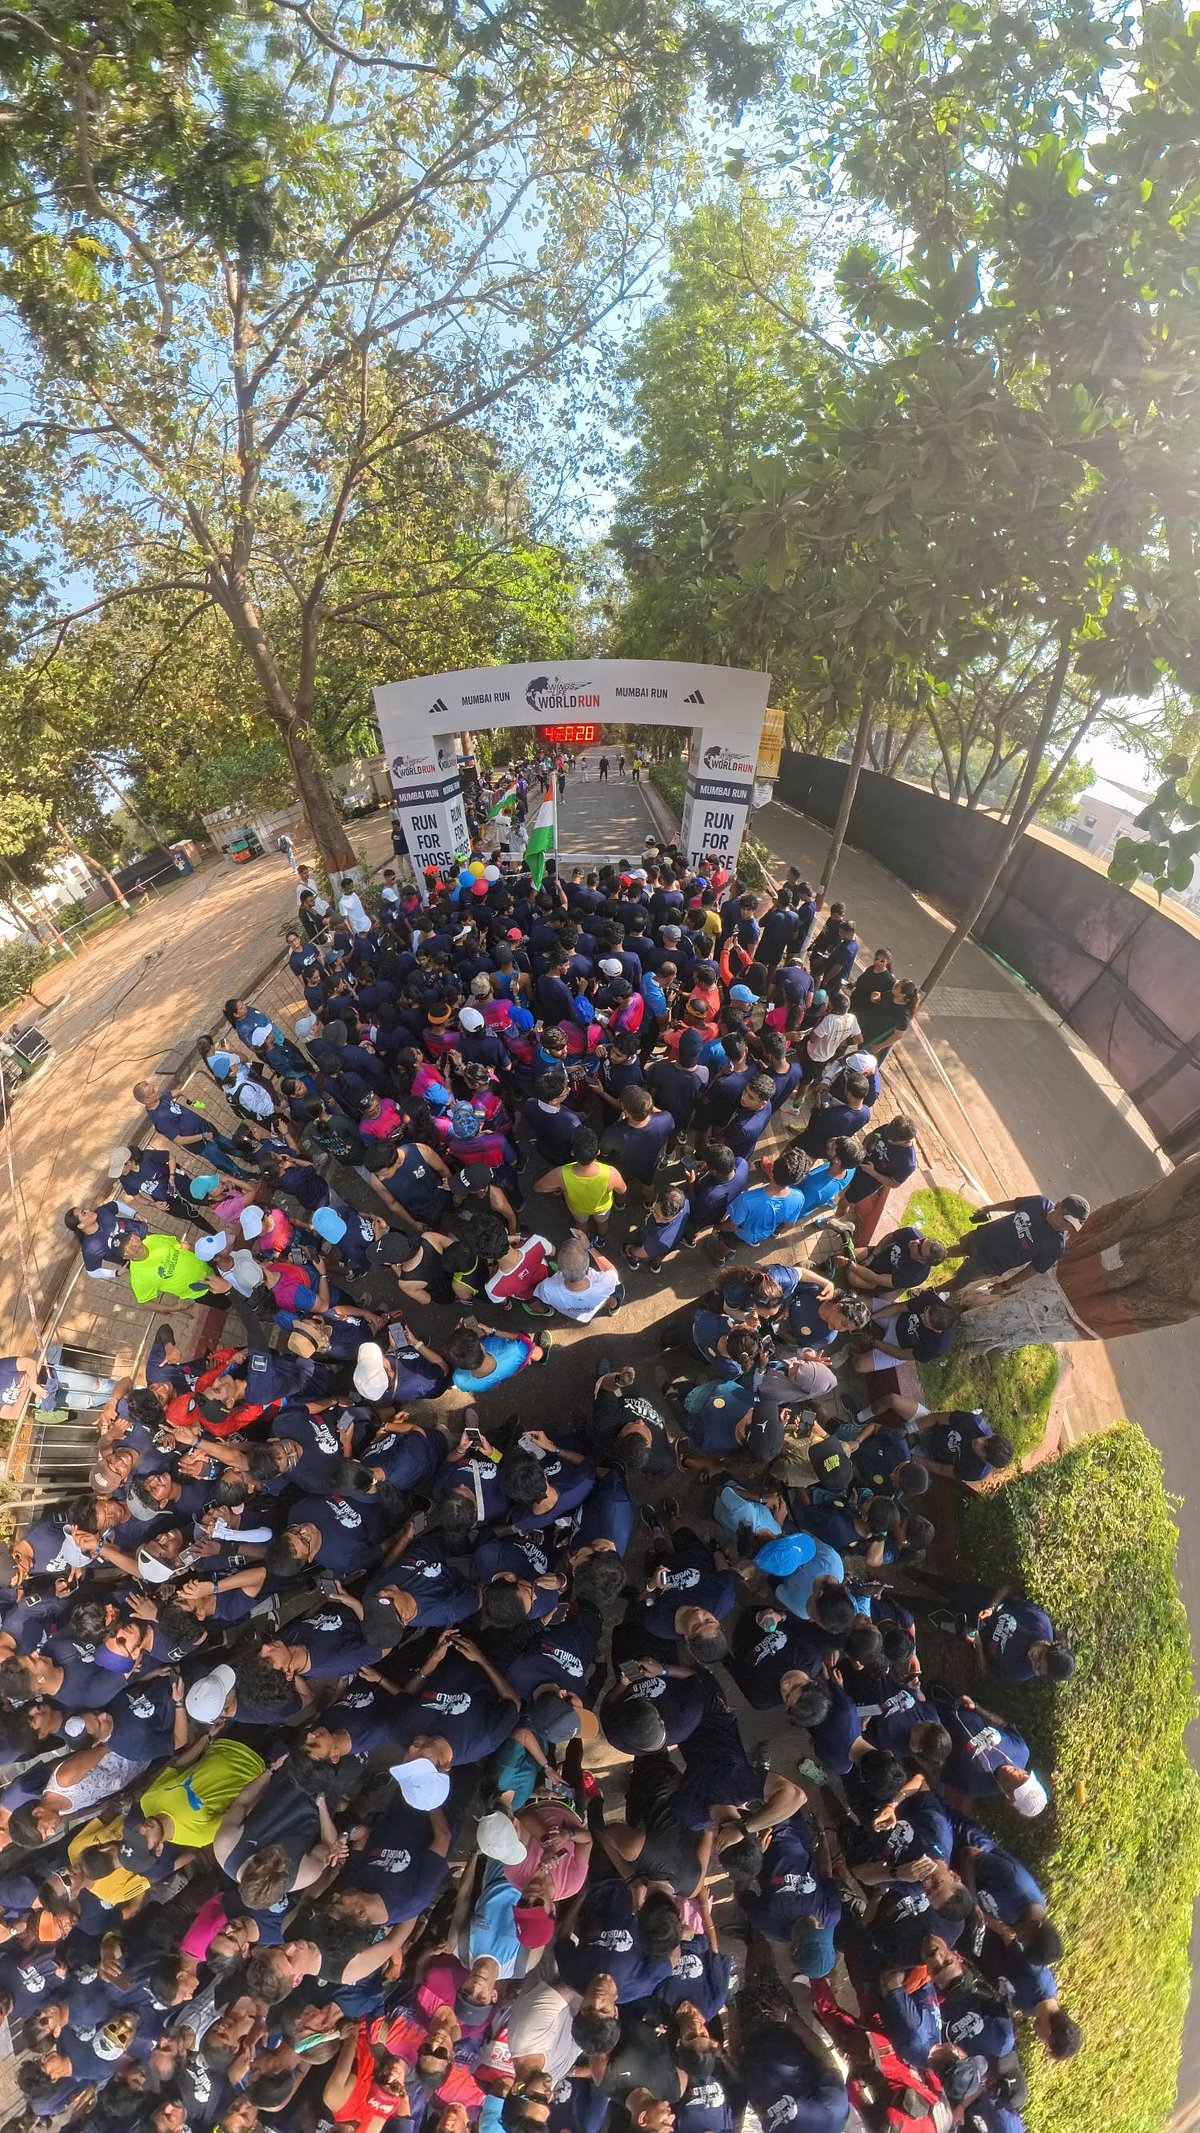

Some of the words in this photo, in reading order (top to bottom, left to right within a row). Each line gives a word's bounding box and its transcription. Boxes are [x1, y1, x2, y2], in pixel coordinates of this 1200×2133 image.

[461, 692, 493, 706] MUMBAI
[494, 691, 510, 702] RUN
[615, 687, 649, 699] MUMBAI
[650, 688, 668, 699] RUN
[538, 695, 577, 709] WORLD
[578, 694, 600, 708] RUN
[400, 765, 422, 778] WORLD
[421, 763, 436, 775] RUN
[711, 760, 738, 771] WORLD
[737, 762, 754, 773] RUN
[399, 790, 425, 803] MUMBAI
[425, 788, 440, 799] RUN
[699, 784, 731, 798] MUMBAI
[731, 789, 748, 799] RUN
[411, 813, 438, 831] RUN
[703, 811, 735, 830] RUN
[454, 823, 466, 841] FOR
[416, 833, 441, 850] FOR
[702, 832, 729, 850] FOR
[413, 851, 453, 868] THOSE
[691, 852, 735, 871] THSE
[526, 1542, 546, 1562] WORLD
[554, 1648, 579, 1666] WORLD
[633, 1677, 657, 1693] WORLD
[436, 1692, 463, 1702] WORLD
[380, 1848, 404, 1859] WORLD
[601, 1929, 625, 1939] WORLD
